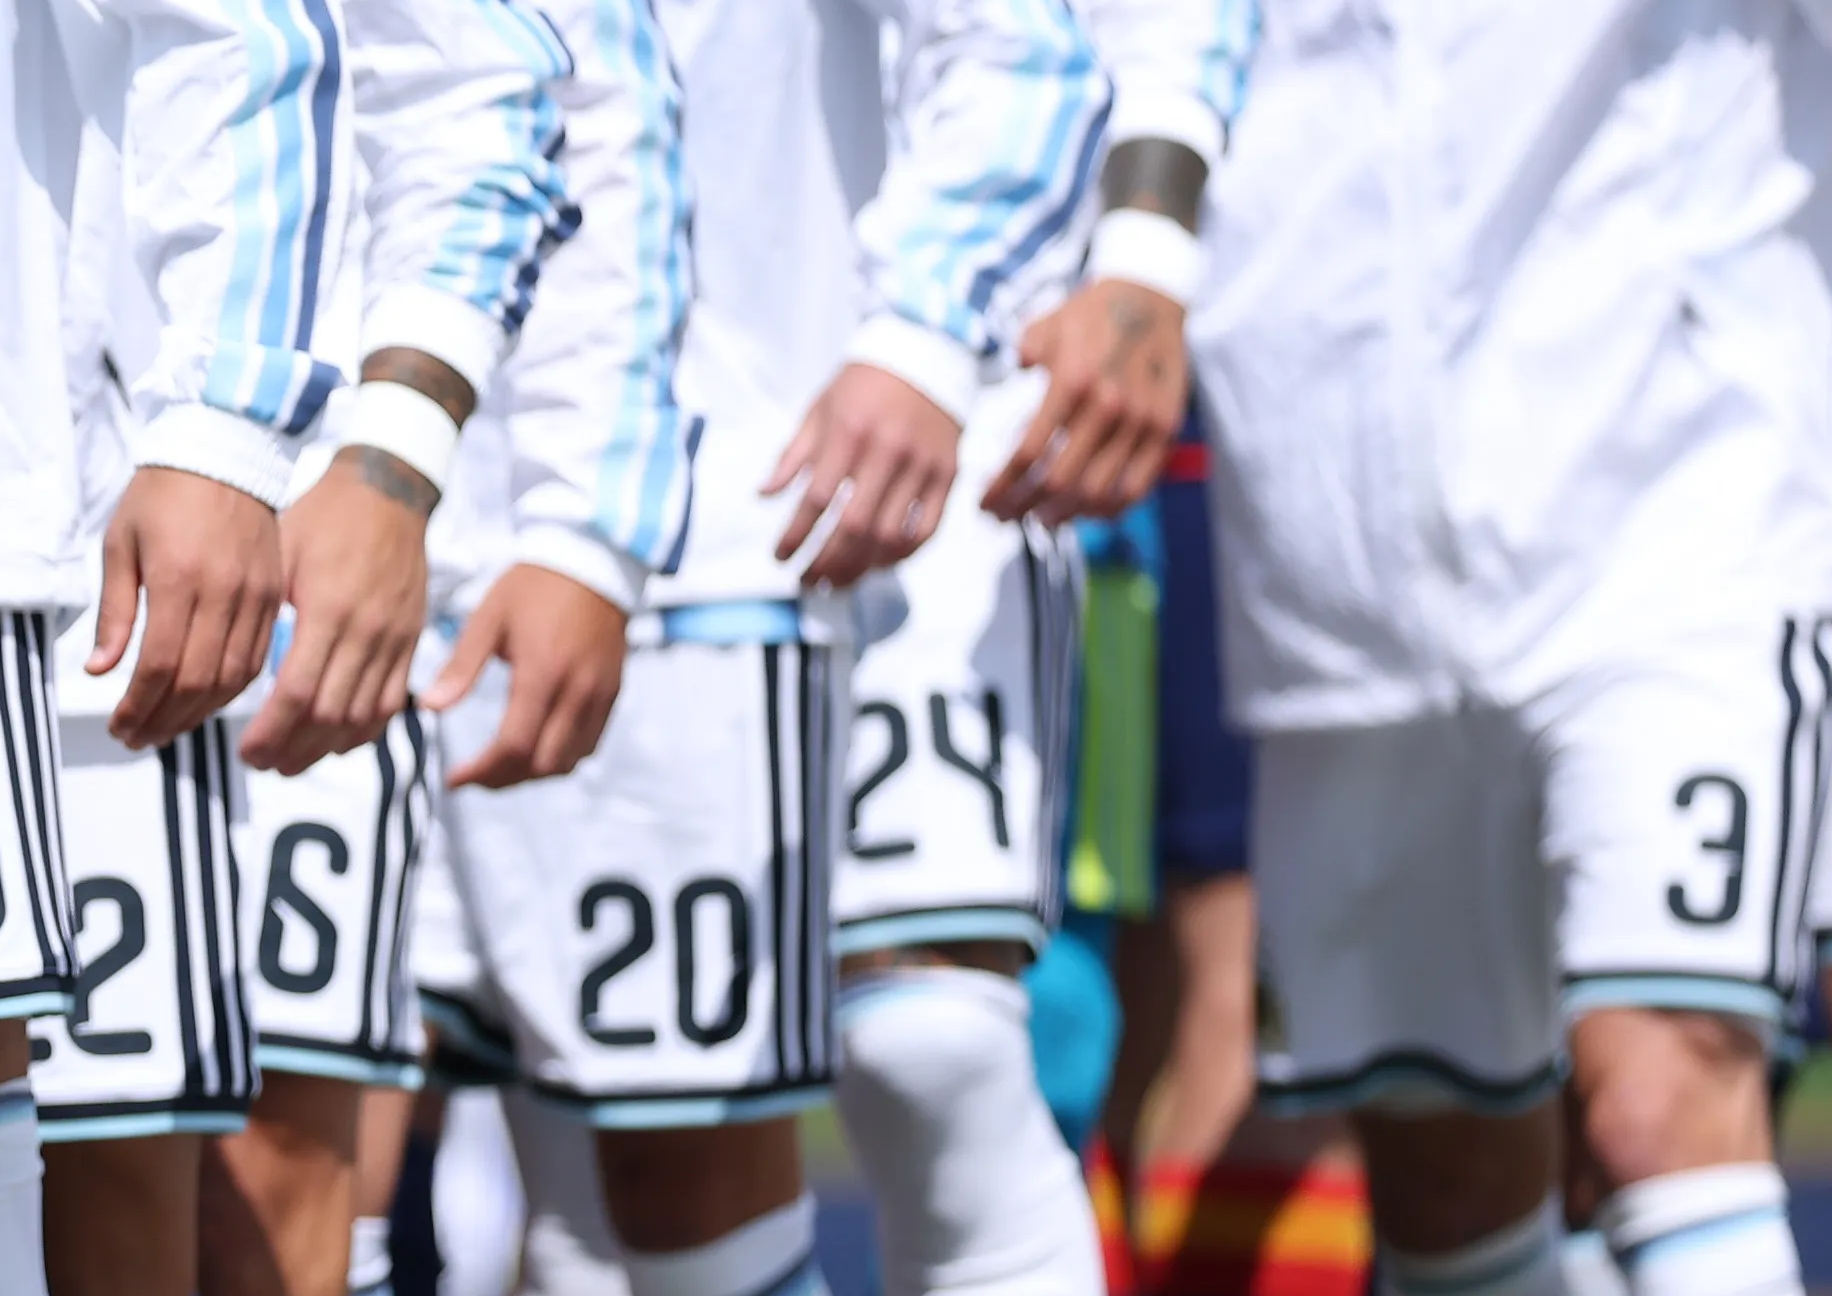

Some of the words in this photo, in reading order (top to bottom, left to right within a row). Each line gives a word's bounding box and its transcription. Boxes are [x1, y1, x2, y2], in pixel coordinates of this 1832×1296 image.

[844, 688, 1009, 862] 24
[1667, 774, 1748, 926] 3
[29, 876, 153, 1062] 2
[258, 822, 349, 994] 6
[578, 876, 756, 1049] 20
